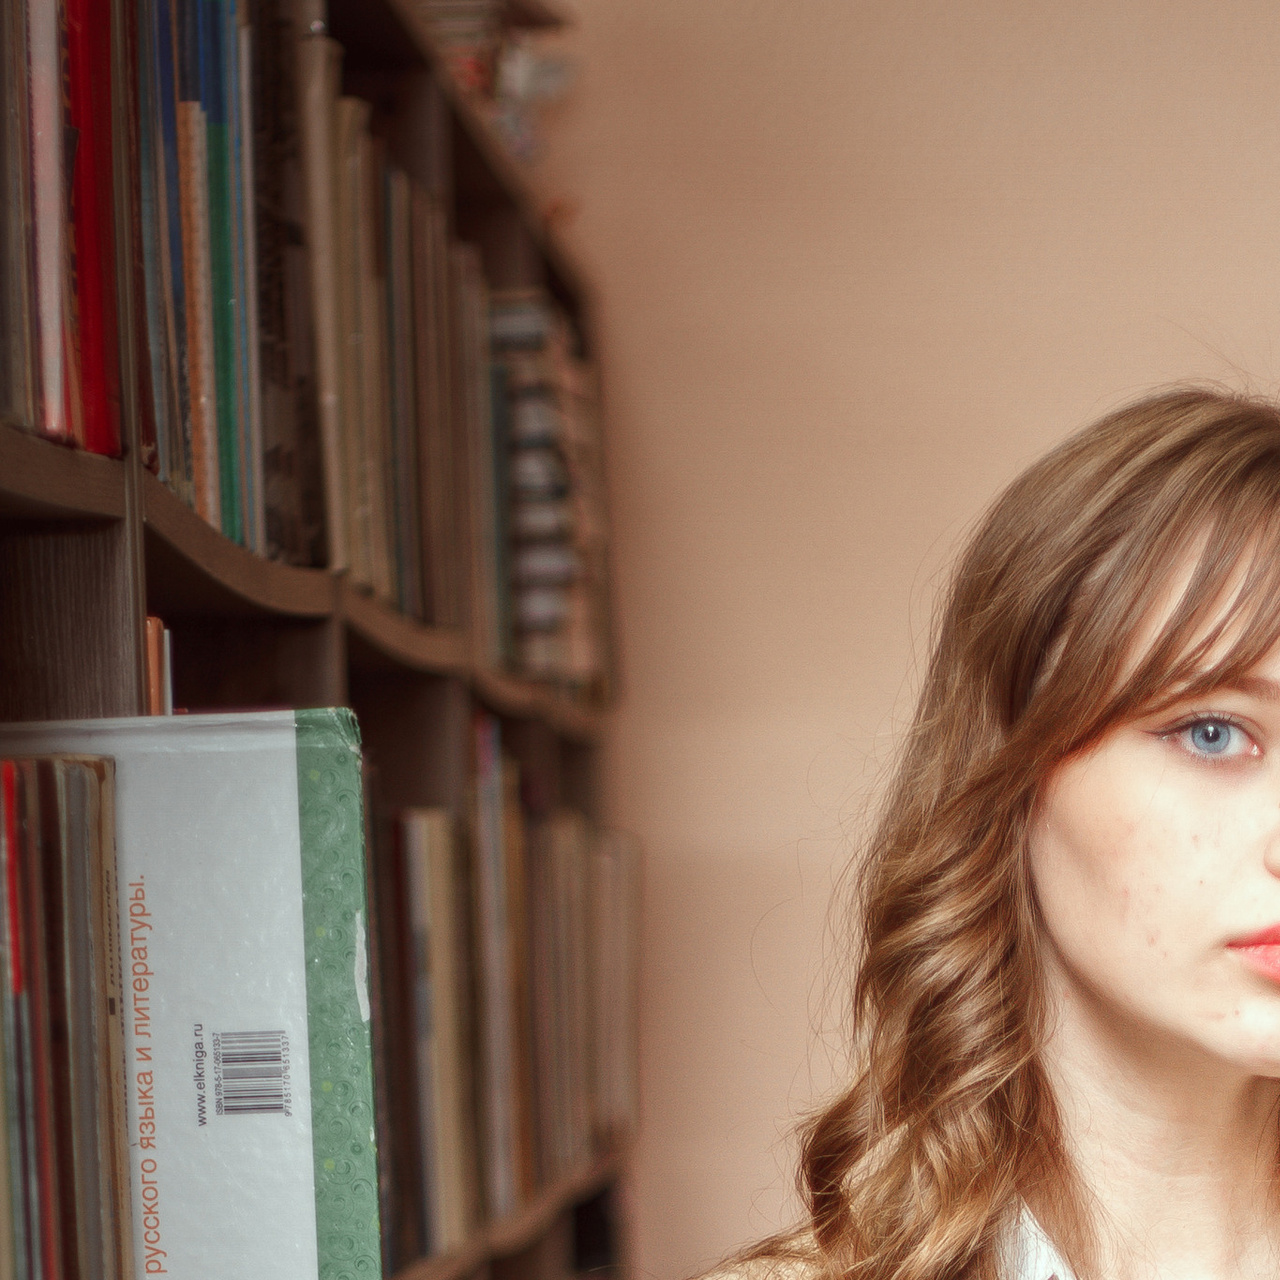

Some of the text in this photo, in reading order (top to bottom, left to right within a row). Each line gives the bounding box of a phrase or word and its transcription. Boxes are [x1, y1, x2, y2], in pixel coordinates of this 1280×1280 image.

[126, 873, 168, 1275] русского языка и литературы.
[192, 1023, 207, 1127] www.elkniga.ru
[212, 1032, 224, 1116] ISBN 978-5-17-065133-7
